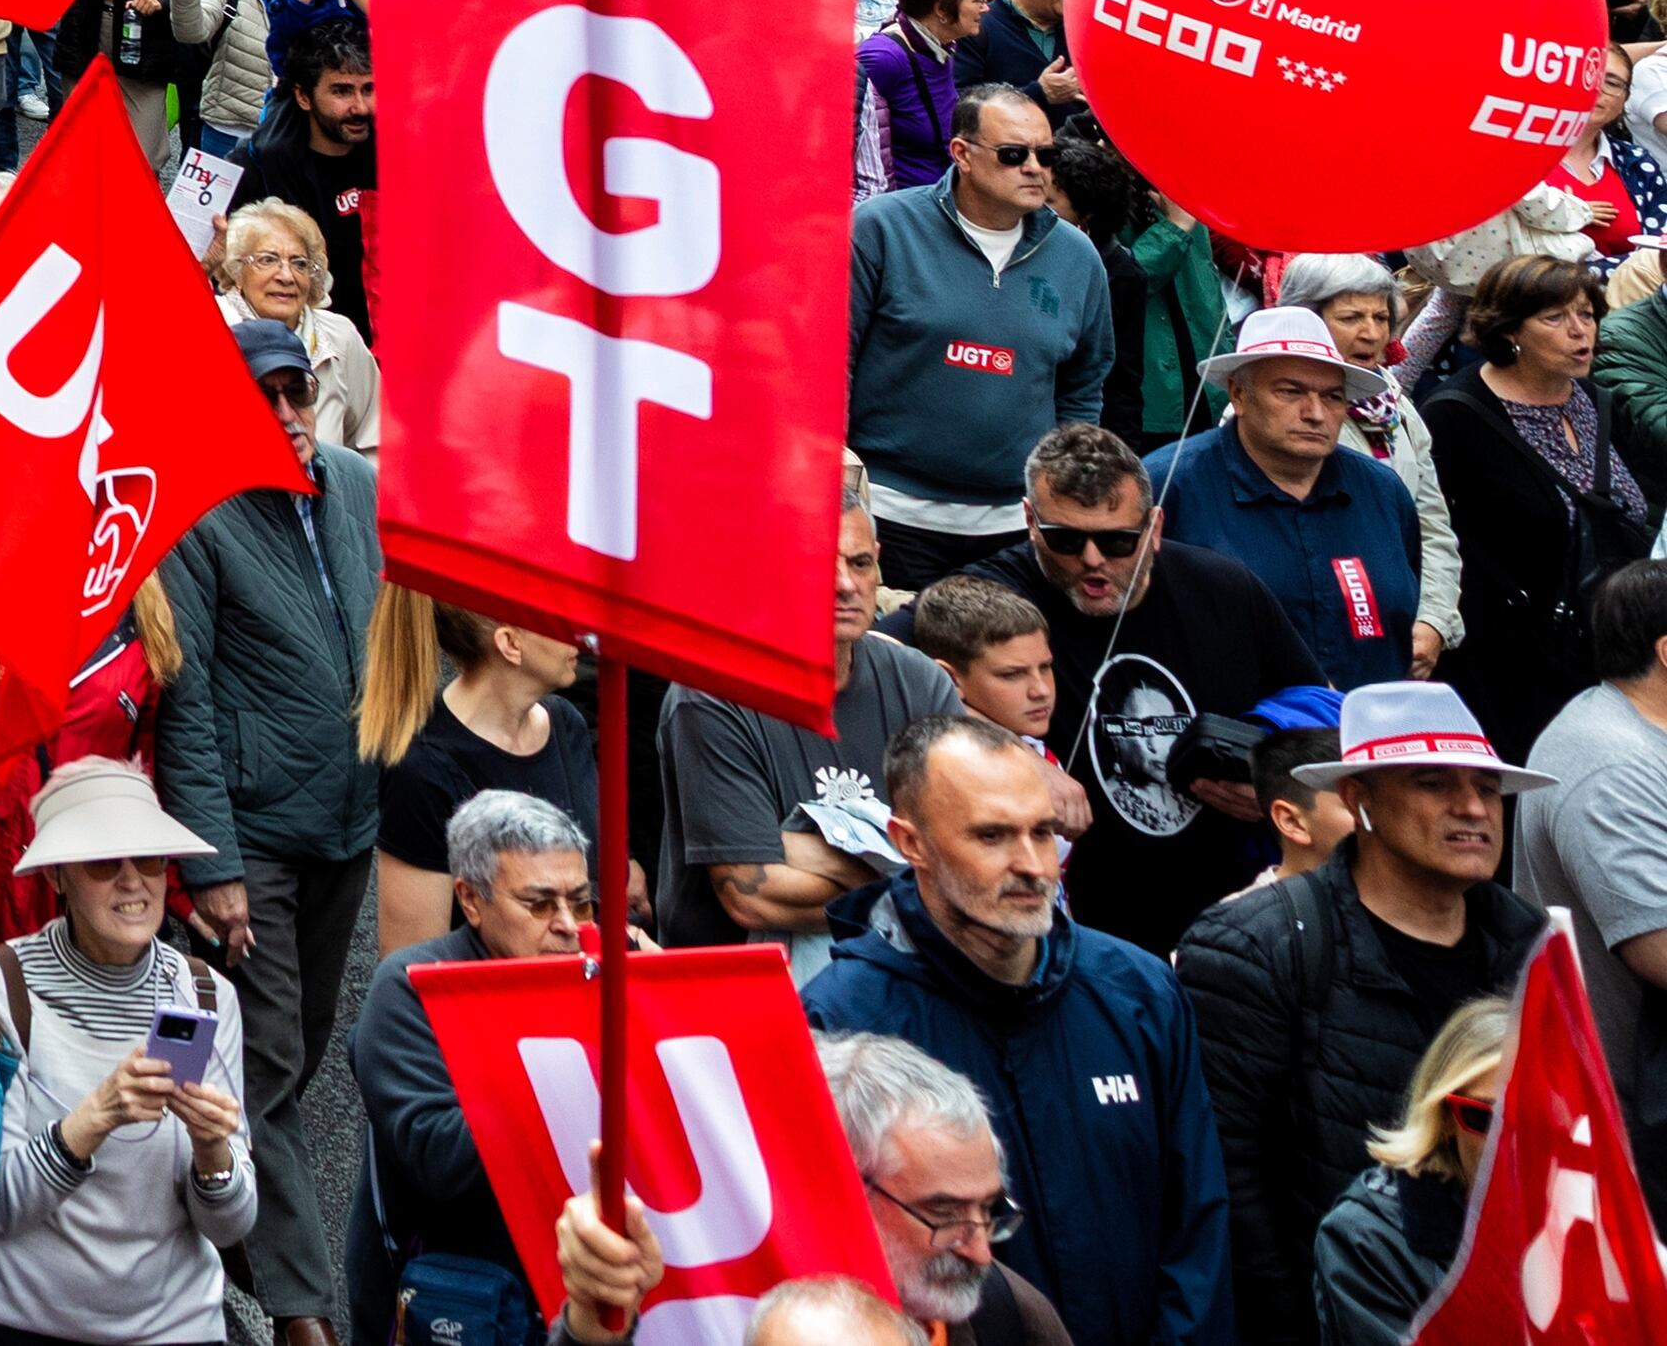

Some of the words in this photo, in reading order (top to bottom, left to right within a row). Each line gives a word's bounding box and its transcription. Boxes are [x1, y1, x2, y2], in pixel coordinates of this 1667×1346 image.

[1275, 3, 1362, 43] Madrid
[1500, 34, 1585, 87] UGT
[1469, 94, 1599, 148] CCOO
[947, 344, 993, 367] UGT
[1339, 559, 1370, 617] CCOO
[1091, 1074, 1139, 1104] HH
